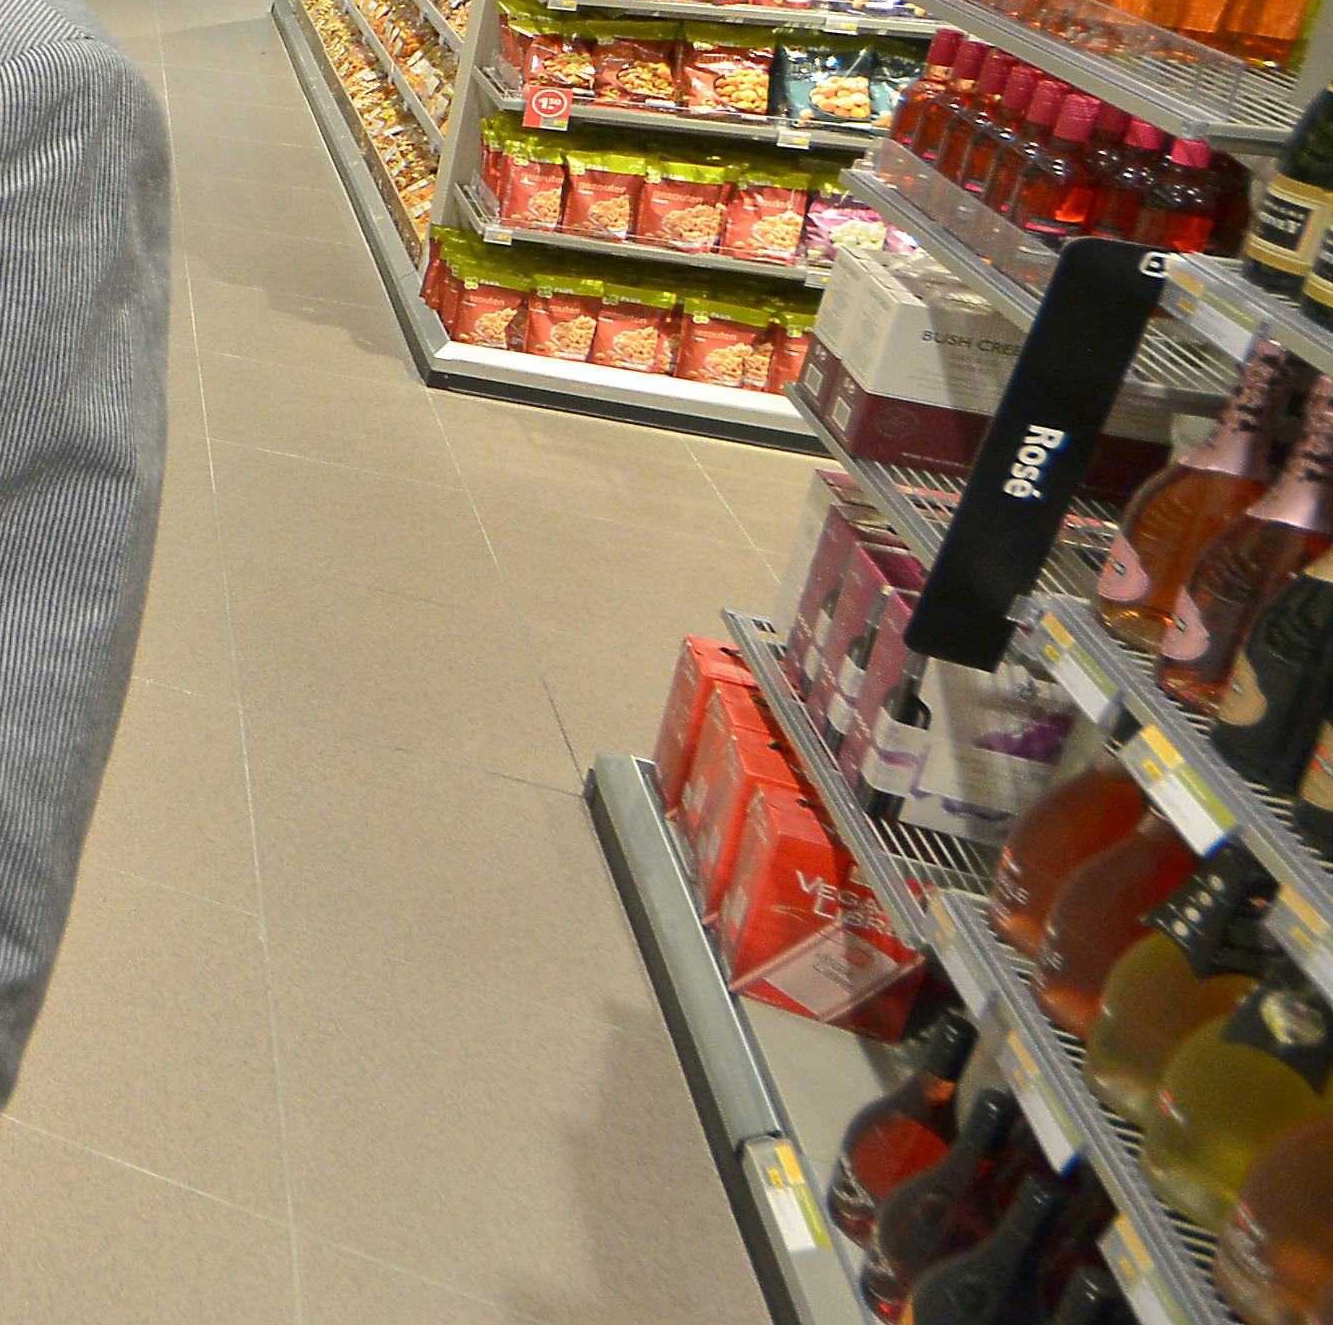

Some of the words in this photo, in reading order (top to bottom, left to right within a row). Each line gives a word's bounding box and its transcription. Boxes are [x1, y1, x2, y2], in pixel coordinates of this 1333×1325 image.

[578, 180, 627, 194] gezouten
[652, 189, 703, 203] gezouten
[922, 330, 973, 350] BUSH
[1003, 423, 1066, 501] Rosé
